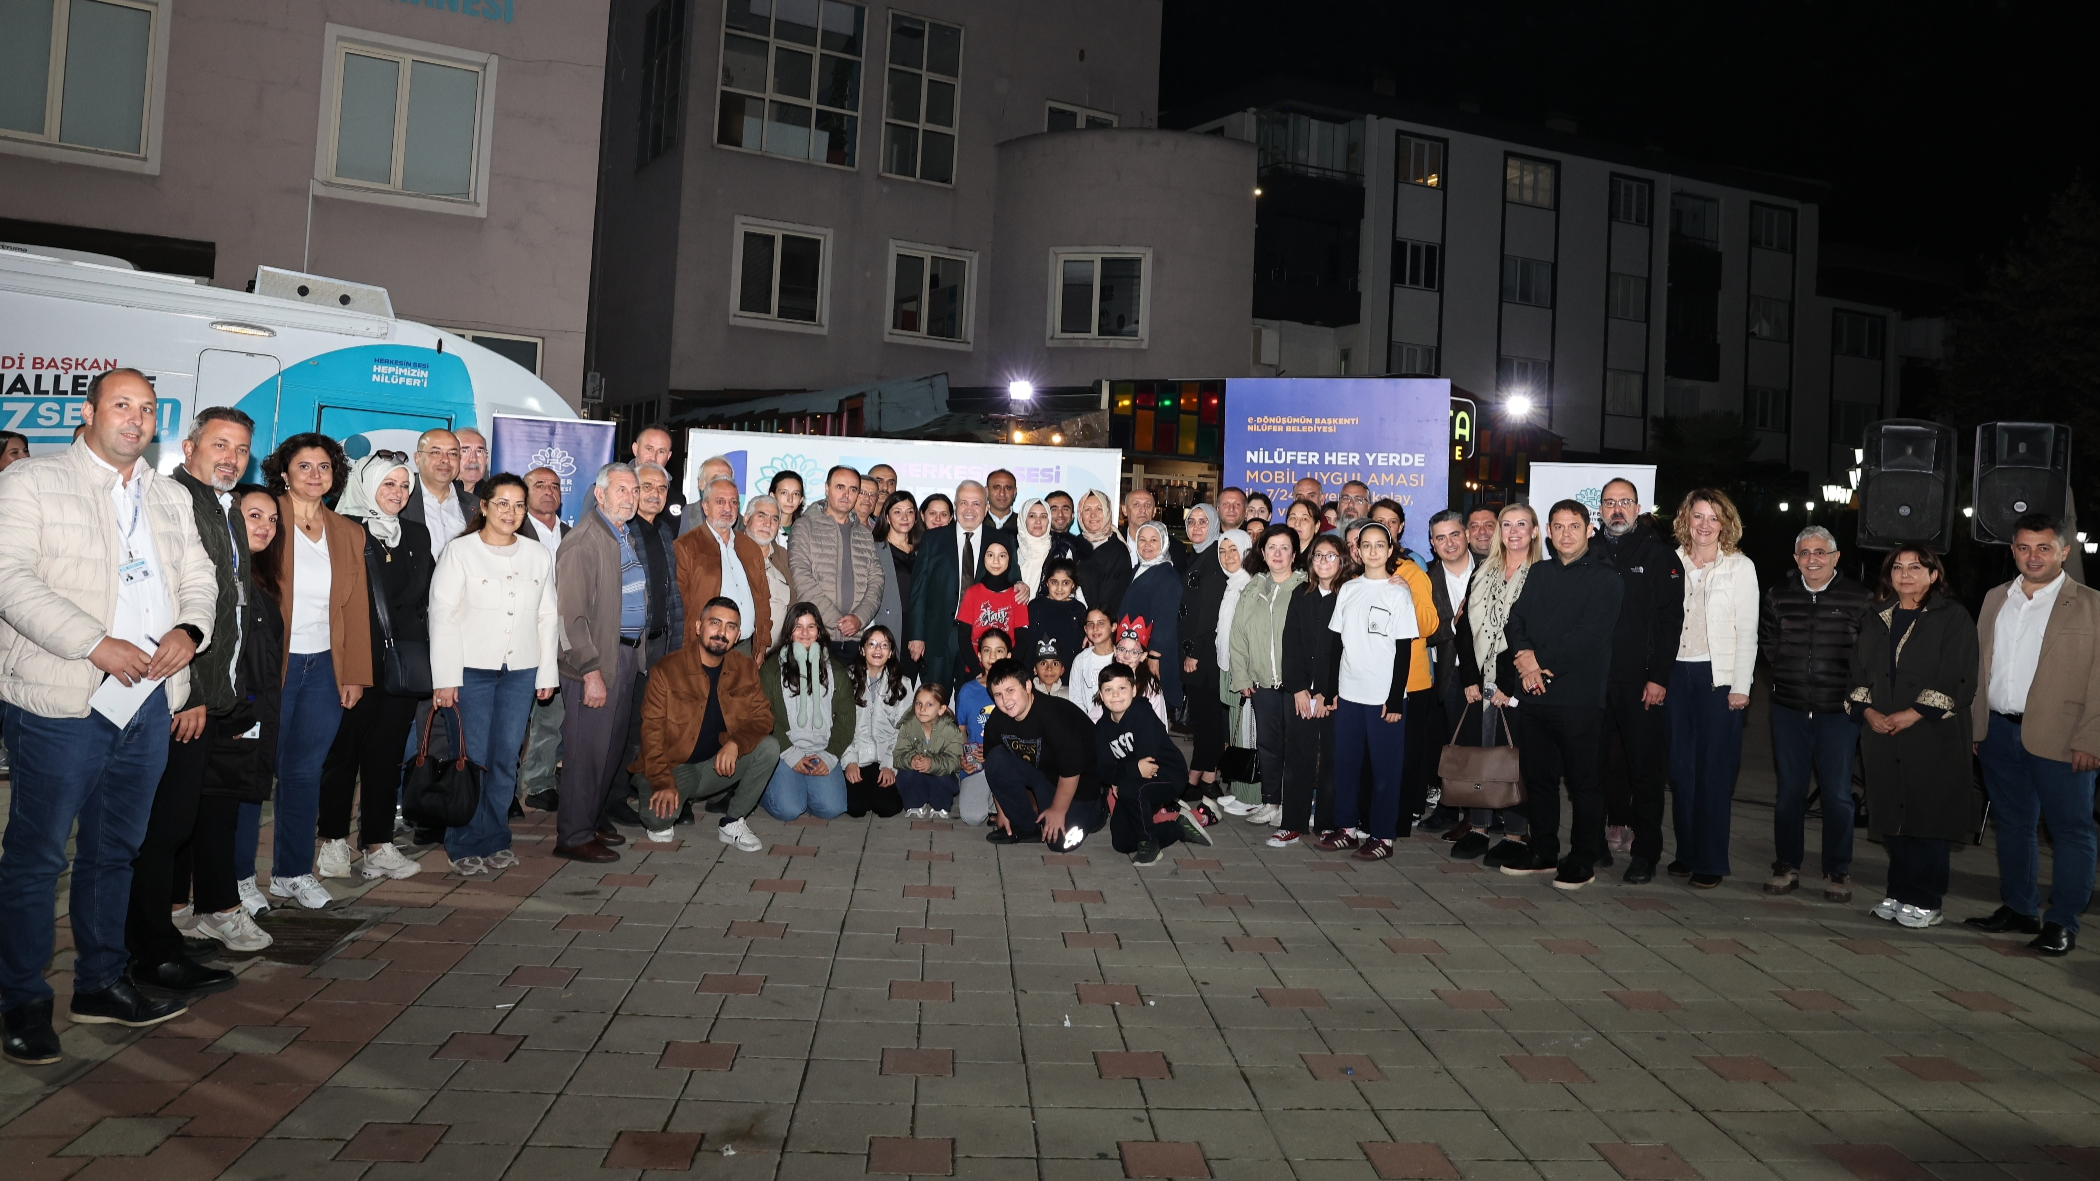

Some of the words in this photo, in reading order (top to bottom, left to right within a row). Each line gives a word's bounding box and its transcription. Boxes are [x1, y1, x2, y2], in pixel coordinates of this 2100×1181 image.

[31, 356, 118, 374] BAŞKAN
[374, 358, 412, 367] HERKESİN
[413, 361, 429, 369] SESİ
[373, 365, 429, 378] HEPİMİZİN
[372, 373, 428, 388] NİLÜFER'İ
[1247, 415, 1312, 425] e-DÖNÜŞÜMÜN
[1314, 416, 1359, 425] BAŞKENTİ
[1247, 424, 1284, 432] NİLÜFER
[1285, 424, 1337, 433] BELEDİYESİ
[1246, 447, 1320, 465] NİLÜFER
[1324, 452, 1360, 466] HER
[1365, 453, 1425, 467] YERDE
[893, 461, 1004, 481] HERKESİ
[1016, 464, 1061, 484] SESİ
[1246, 468, 1298, 485] MOBİL
